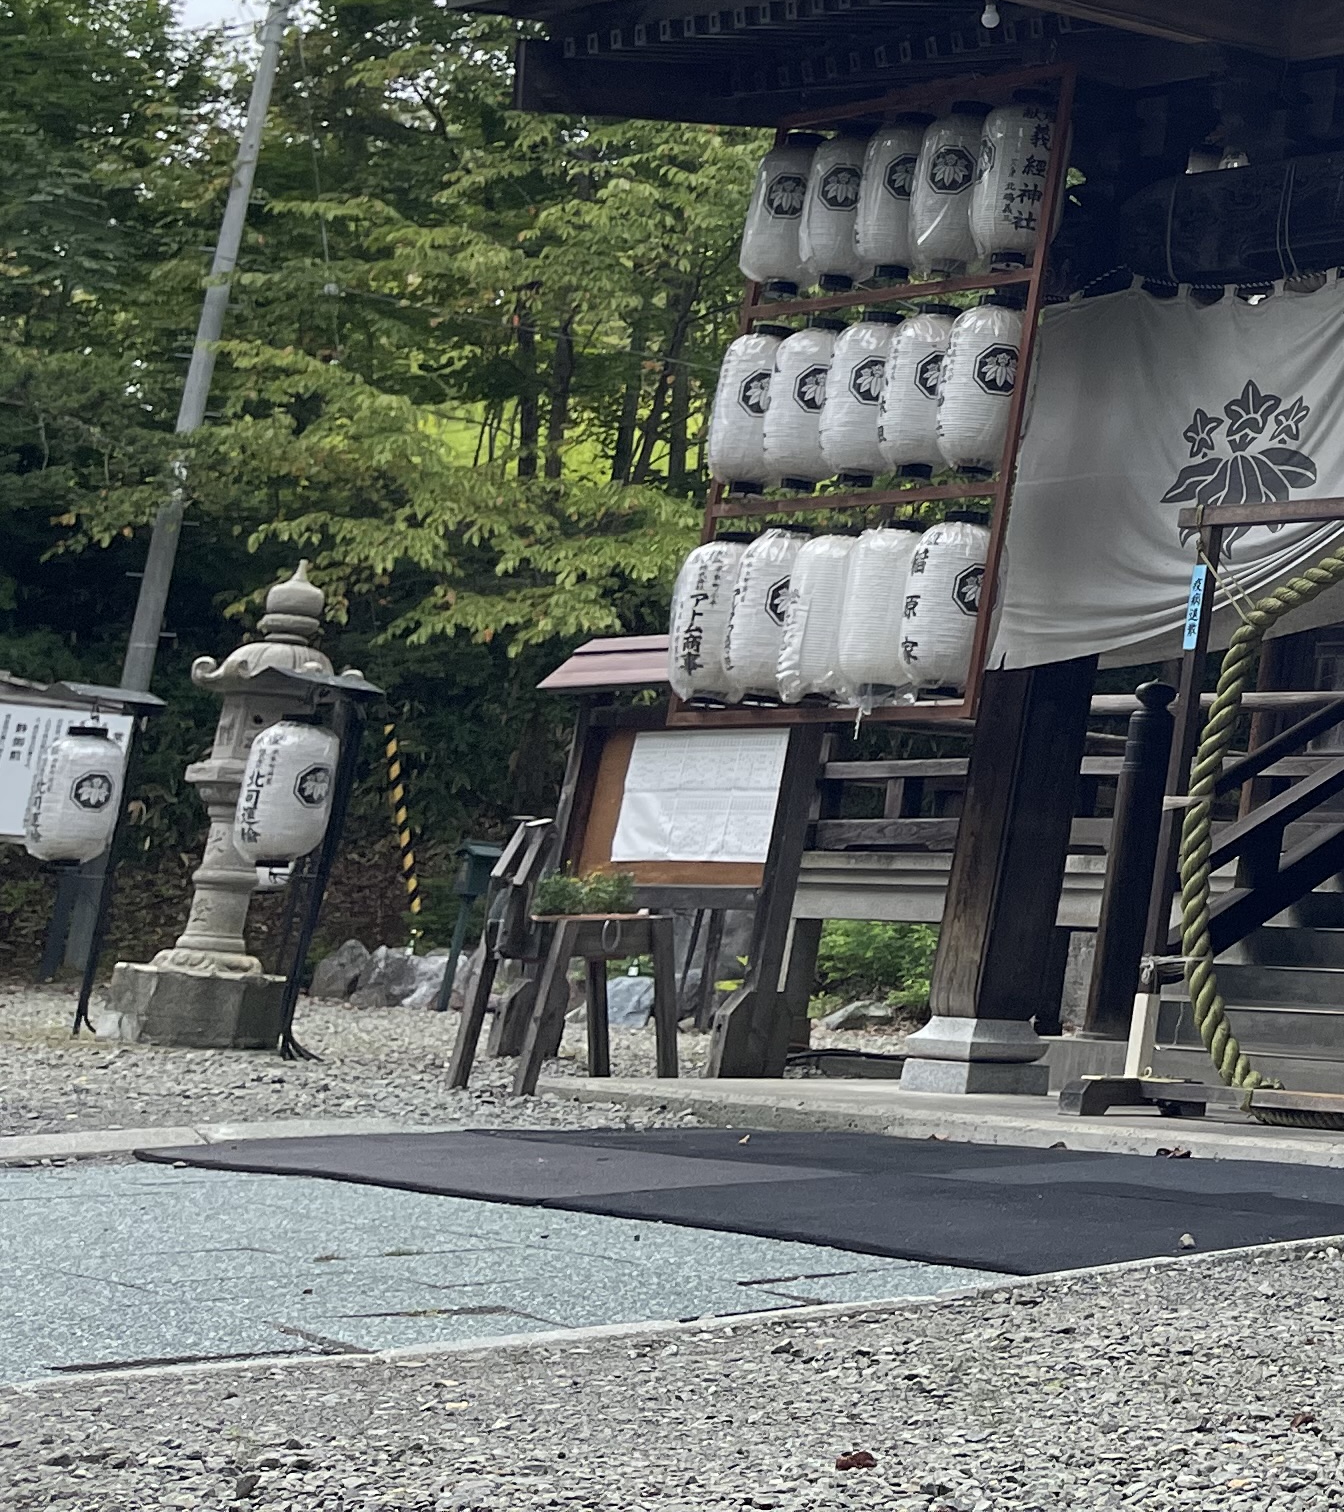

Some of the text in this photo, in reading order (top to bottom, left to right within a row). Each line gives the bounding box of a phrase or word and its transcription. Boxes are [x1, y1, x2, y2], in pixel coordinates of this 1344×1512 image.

[679, 592, 709, 677] アトム商事
